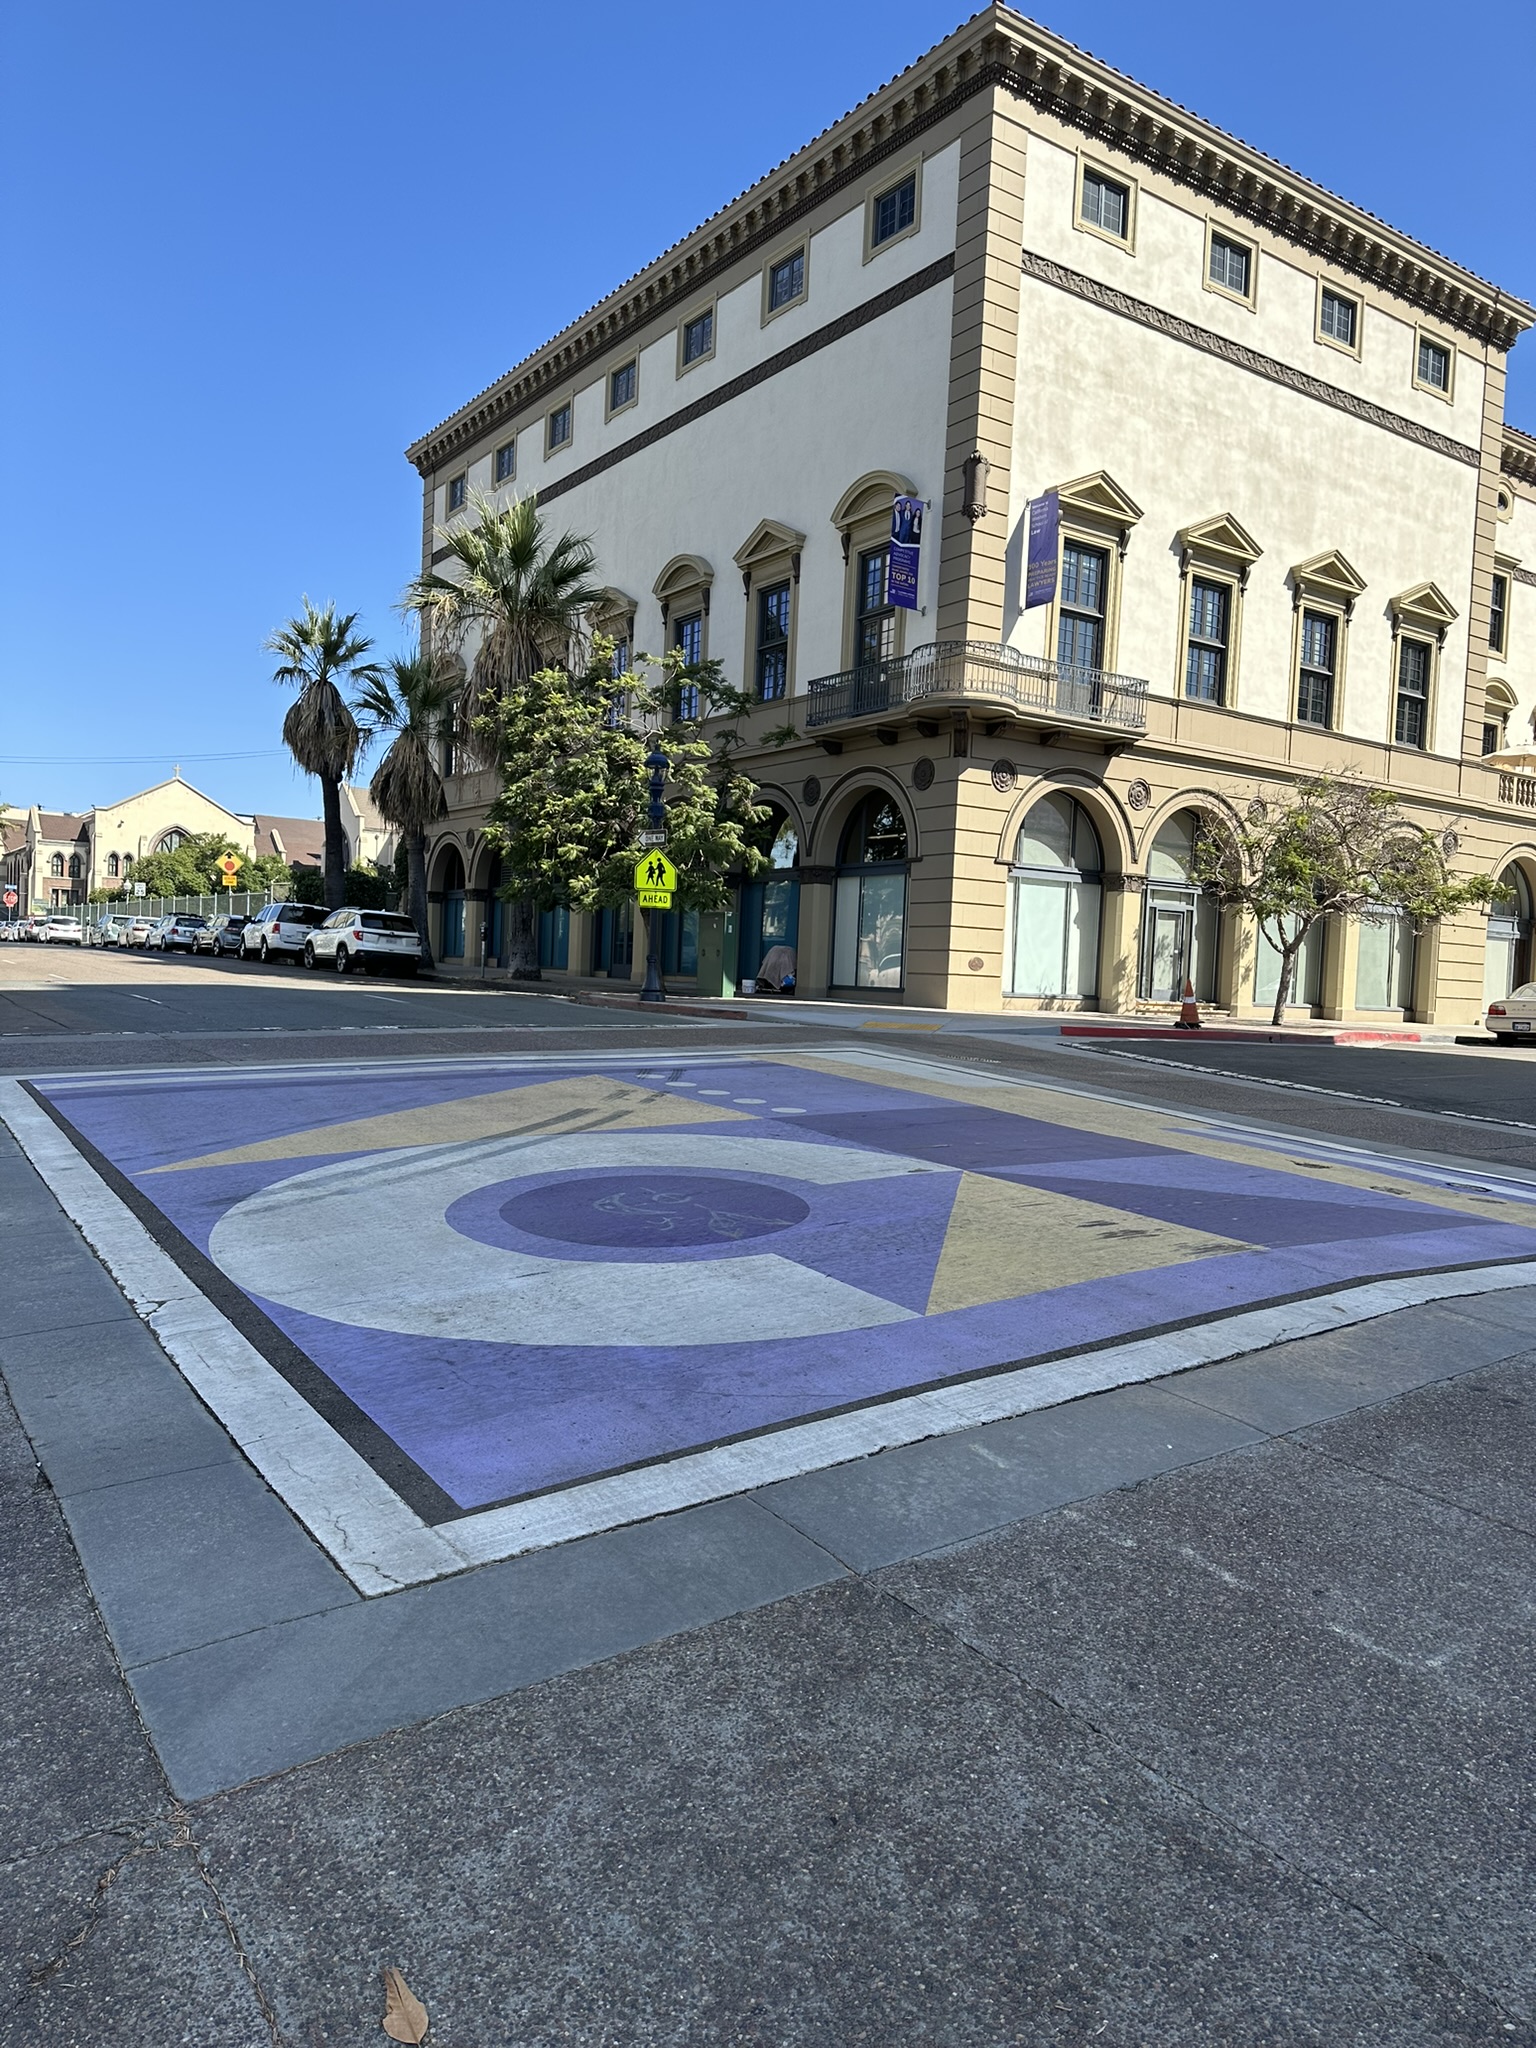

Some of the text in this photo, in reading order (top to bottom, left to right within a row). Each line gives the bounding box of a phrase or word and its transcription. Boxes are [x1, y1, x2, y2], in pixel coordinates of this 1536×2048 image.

[1040, 558, 1057, 567] Years
[1028, 566, 1057, 577] PREPARING
[891, 572, 906, 581] TOP
[908, 576, 915, 585] 10
[1028, 577, 1055, 589] LAWYERS
[643, 895, 668, 903] AHEAD
